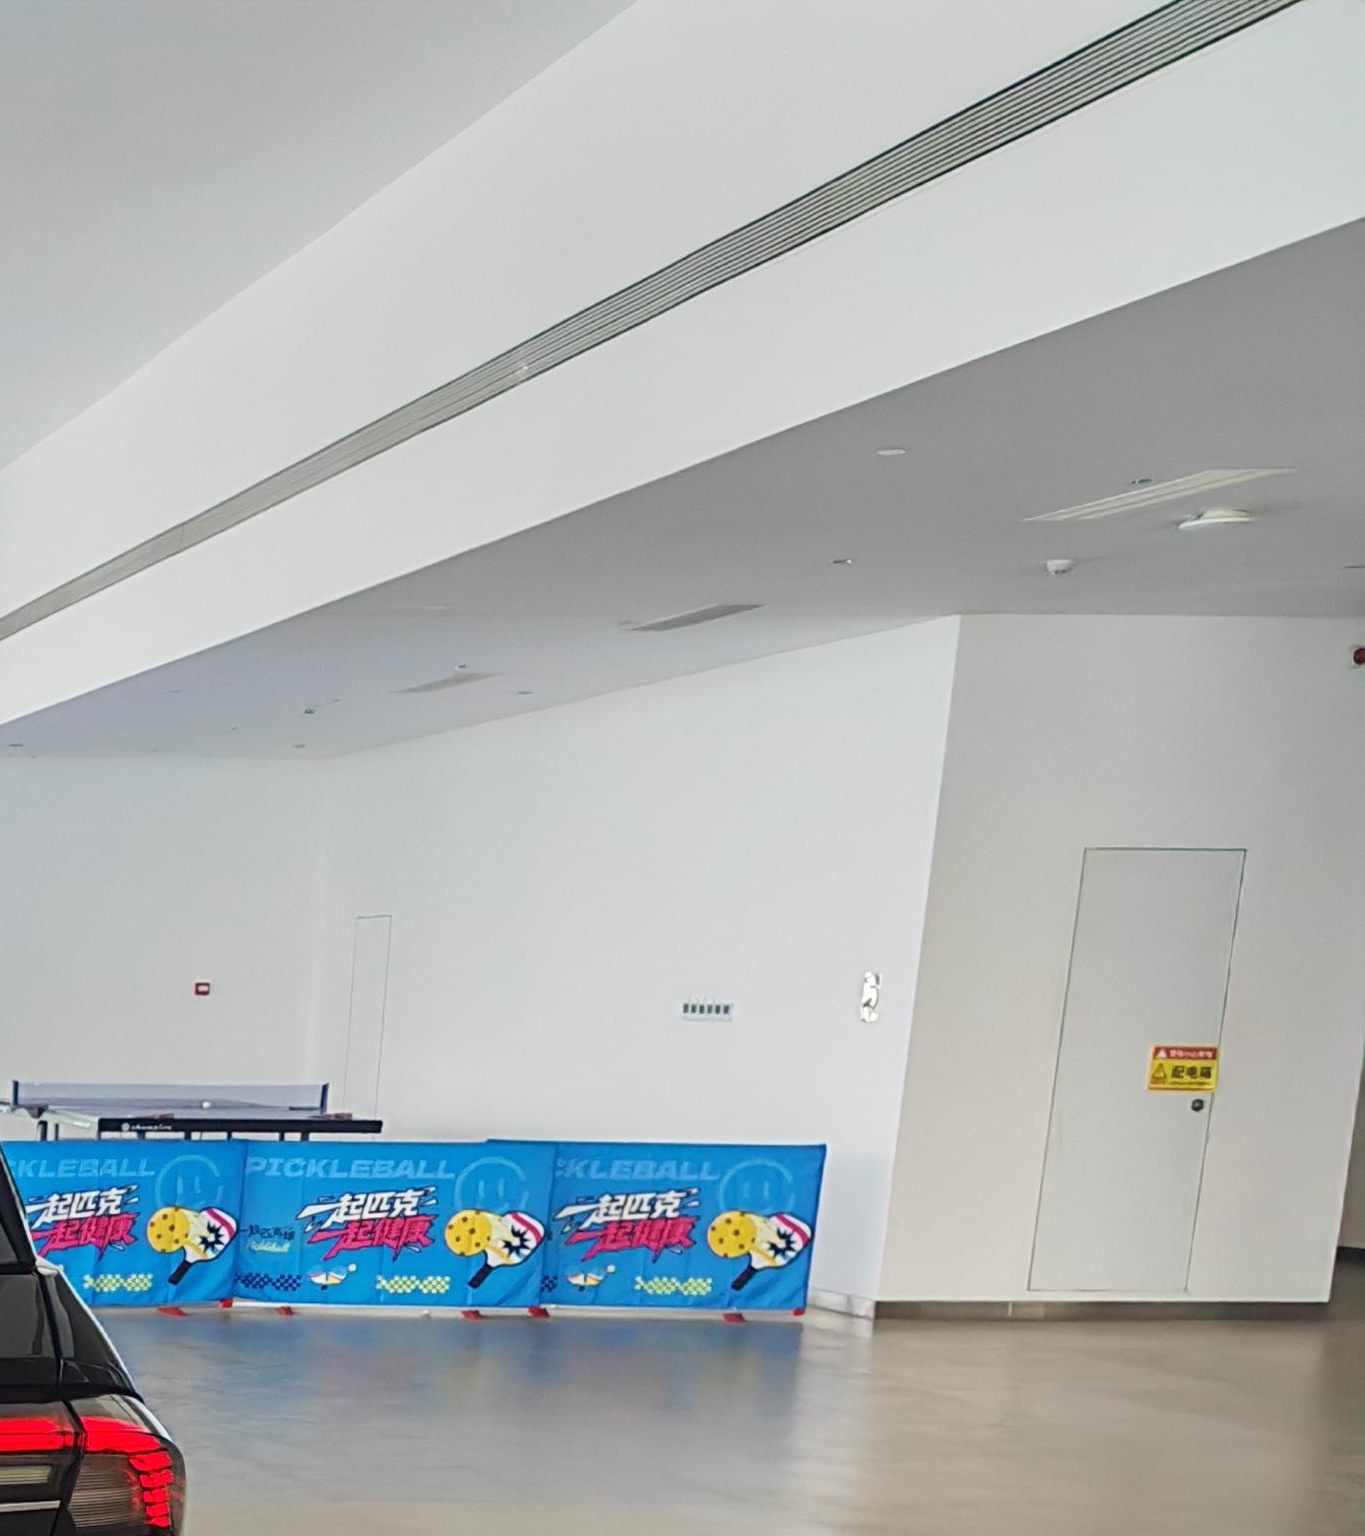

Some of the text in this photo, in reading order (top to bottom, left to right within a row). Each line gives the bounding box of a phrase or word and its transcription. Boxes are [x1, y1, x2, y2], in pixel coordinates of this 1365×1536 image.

[1171, 1065, 1212, 1080] 配电箱
[245, 1157, 455, 1180] PICKLEBALL
[296, 1189, 425, 1230] 一起匹克
[555, 1190, 688, 1230] 一起匹克
